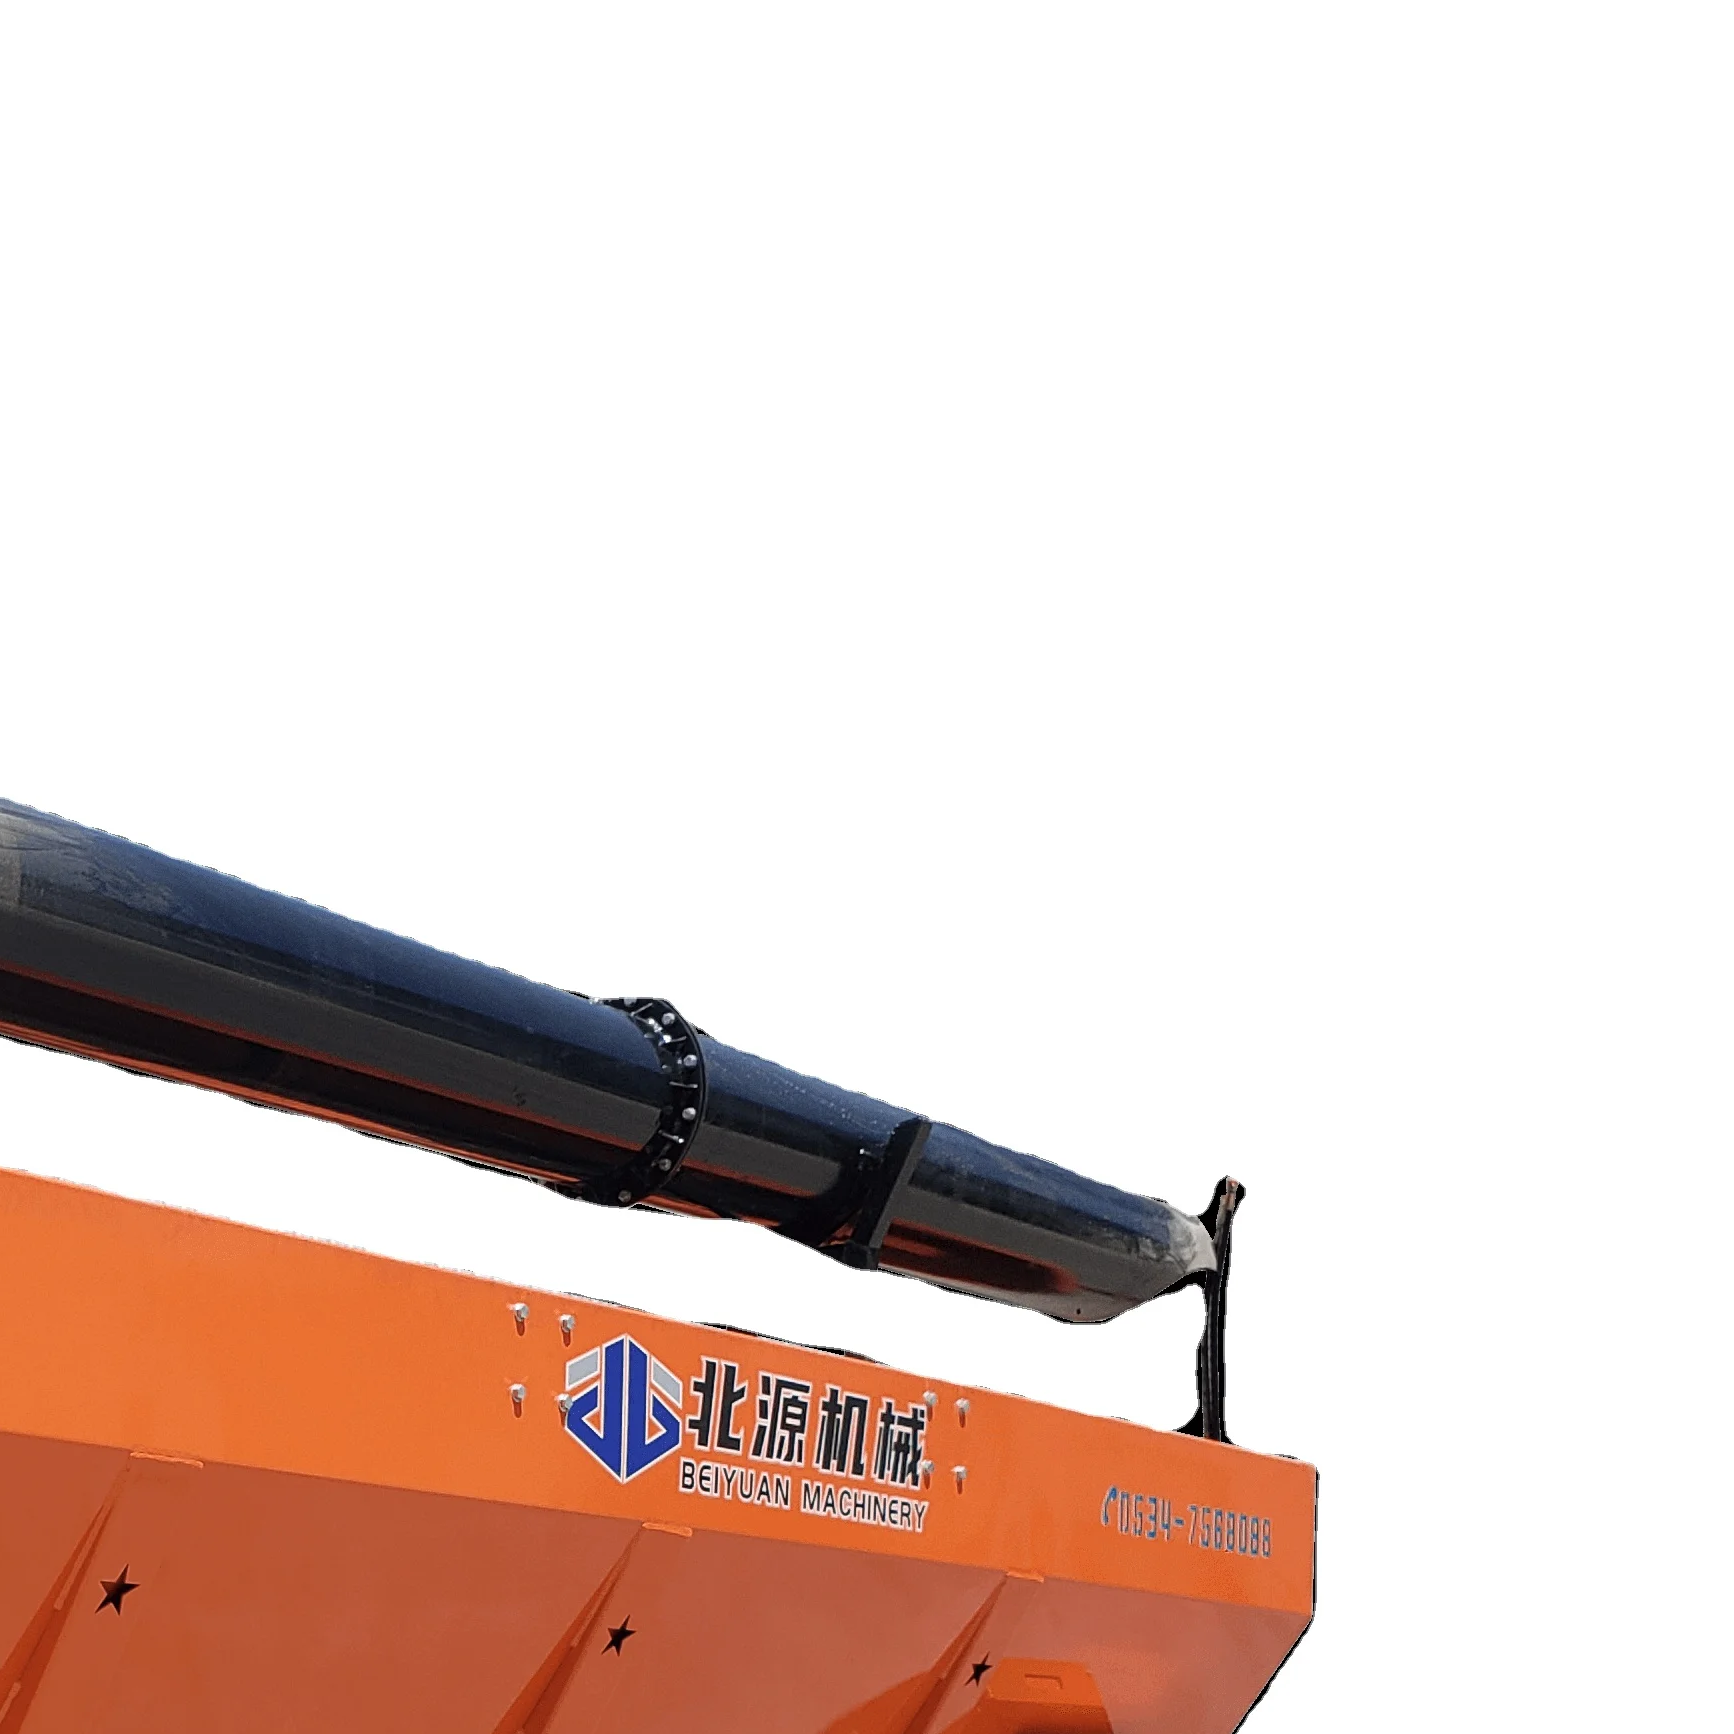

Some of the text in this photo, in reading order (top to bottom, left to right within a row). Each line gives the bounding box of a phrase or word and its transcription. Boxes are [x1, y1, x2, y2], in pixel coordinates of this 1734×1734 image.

[686, 1357, 927, 1489] 北源机械
[679, 1457, 929, 1533] BEIYUAN MACHINERY
